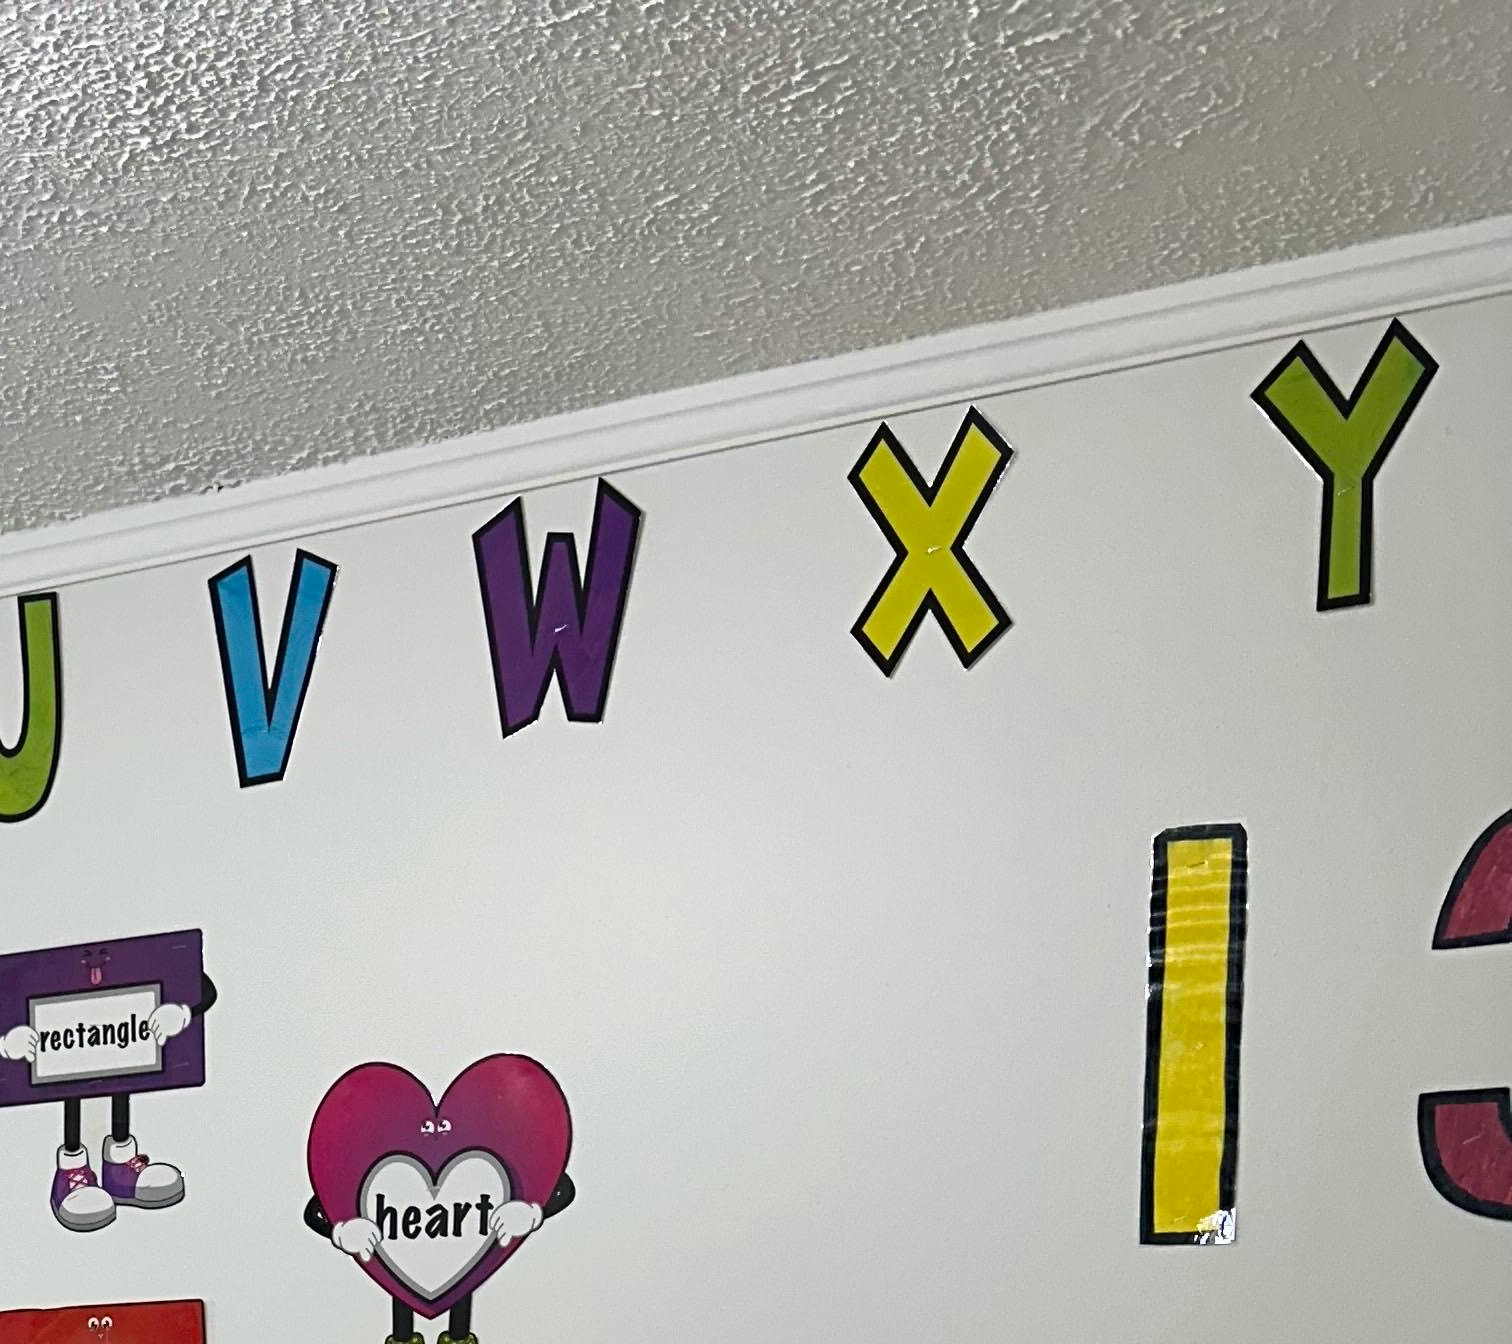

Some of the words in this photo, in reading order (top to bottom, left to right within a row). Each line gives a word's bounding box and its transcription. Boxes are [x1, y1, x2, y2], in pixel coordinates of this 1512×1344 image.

[208, 549, 338, 789] V
[472, 477, 642, 739] W
[847, 404, 1014, 678] X
[1250, 317, 1440, 611] Y
[39, 1013, 150, 1053] rectangle
[1140, 822, 1247, 1246] 1
[376, 1193, 494, 1240] heart
